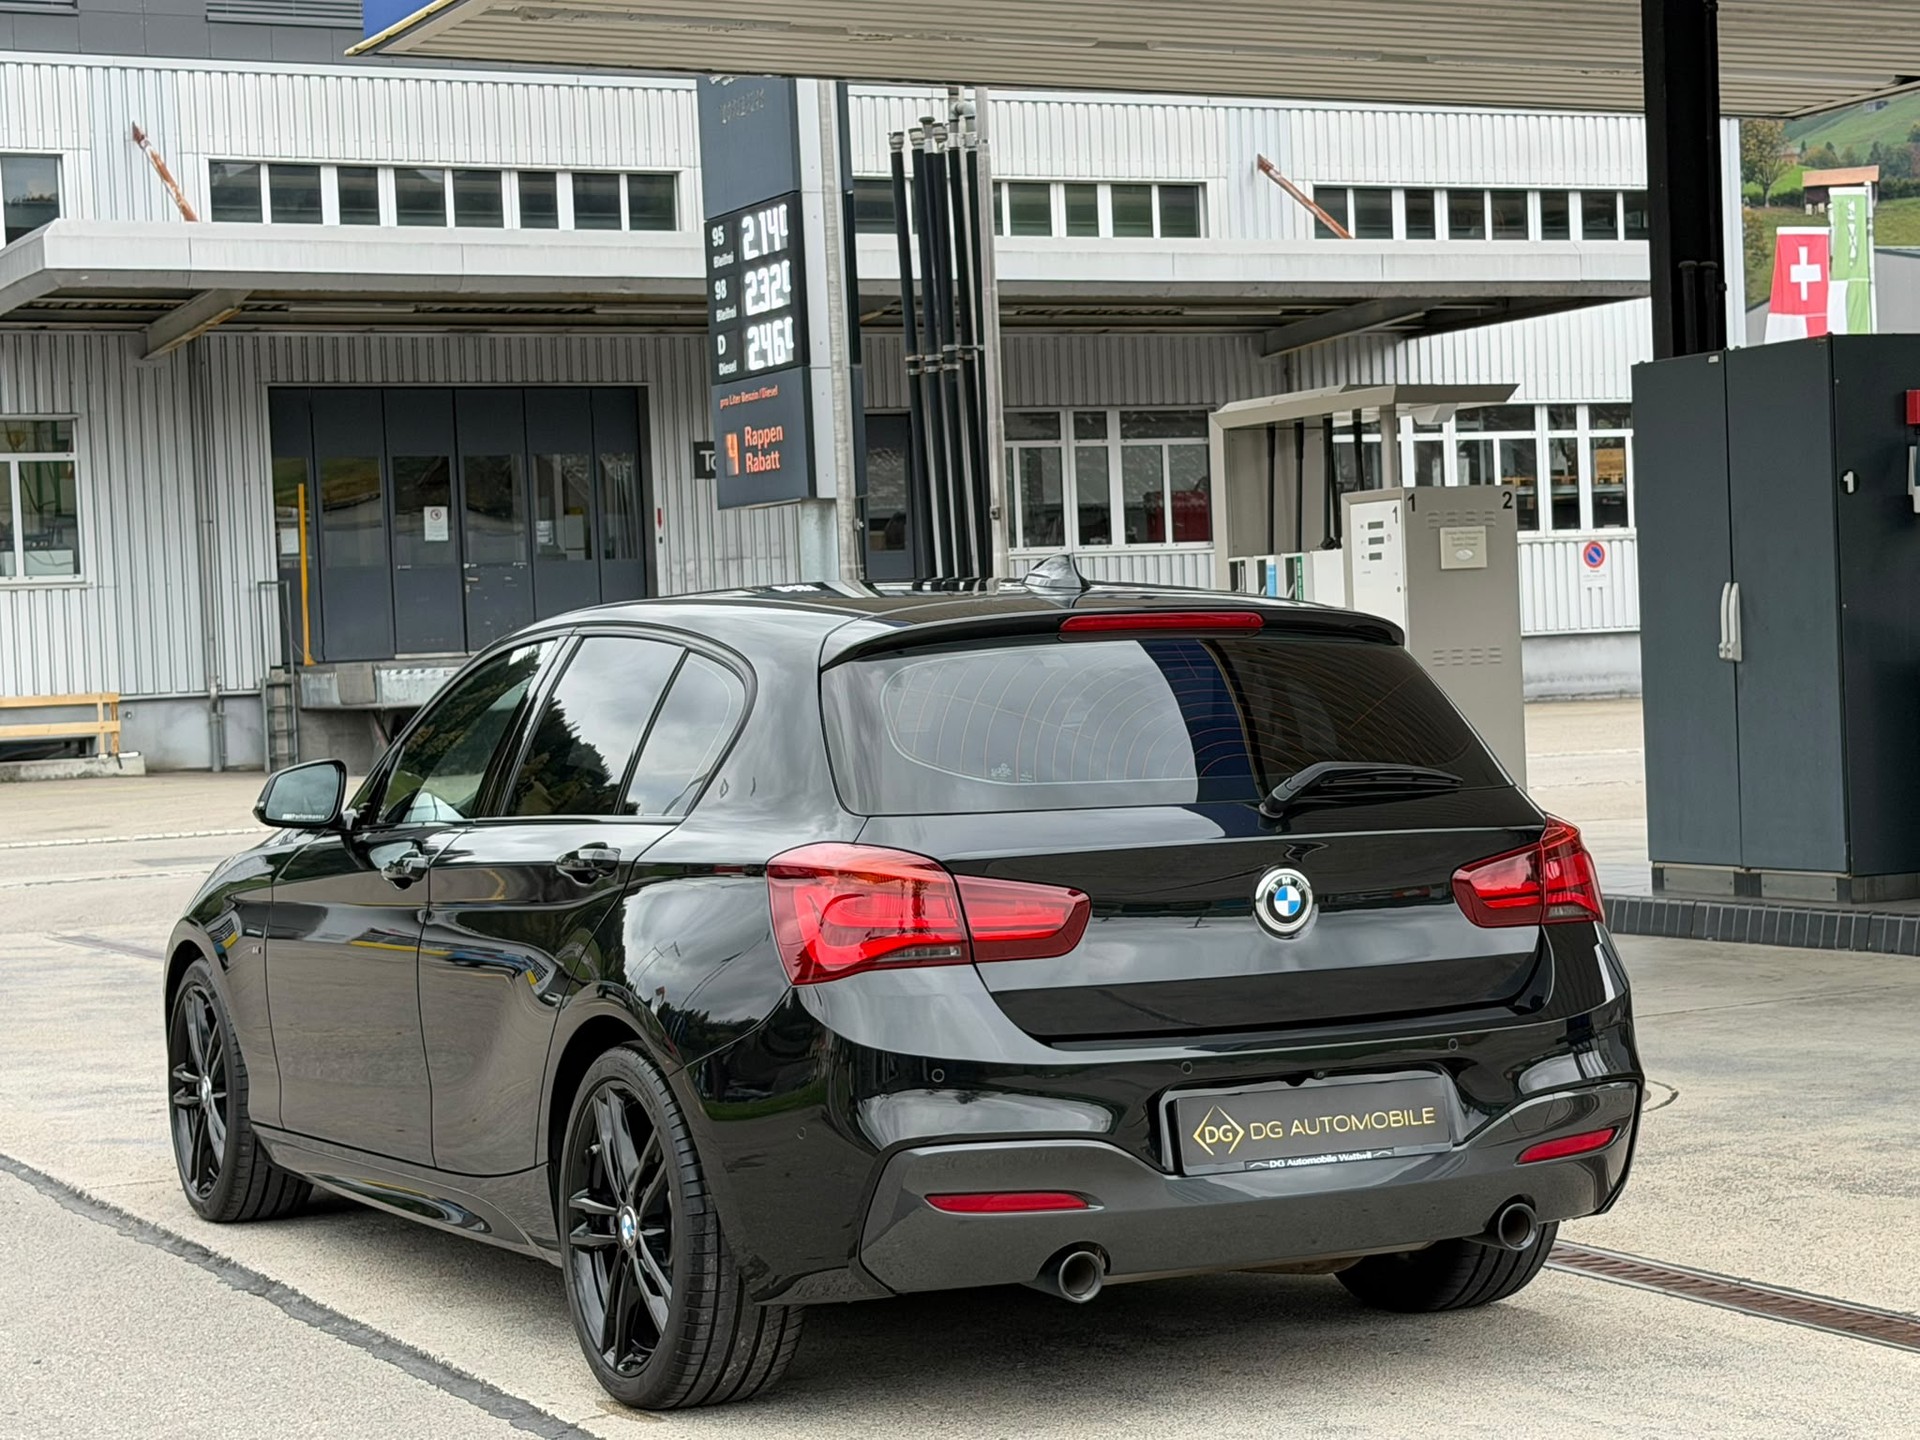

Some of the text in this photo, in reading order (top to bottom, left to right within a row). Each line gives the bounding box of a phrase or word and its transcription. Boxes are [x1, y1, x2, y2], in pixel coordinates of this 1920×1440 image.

[712, 225, 724, 247] 95
[714, 279, 727, 300] 98
[717, 334, 727, 356] D
[718, 360, 738, 376] Diesel
[744, 424, 784, 450] Rappen
[745, 451, 781, 474] Rabatt
[1843, 471, 1854, 493] 1
[1407, 491, 1514, 513] 1 2
[1391, 506, 1399, 525] 1
[1268, 877, 1304, 893] BMW
[1204, 1124, 1234, 1144] DG
[1249, 1106, 1436, 1140] DG AUTOMOBILE
[1269, 1159, 1286, 1169] DG
[1286, 1154, 1338, 1167] Automobile
